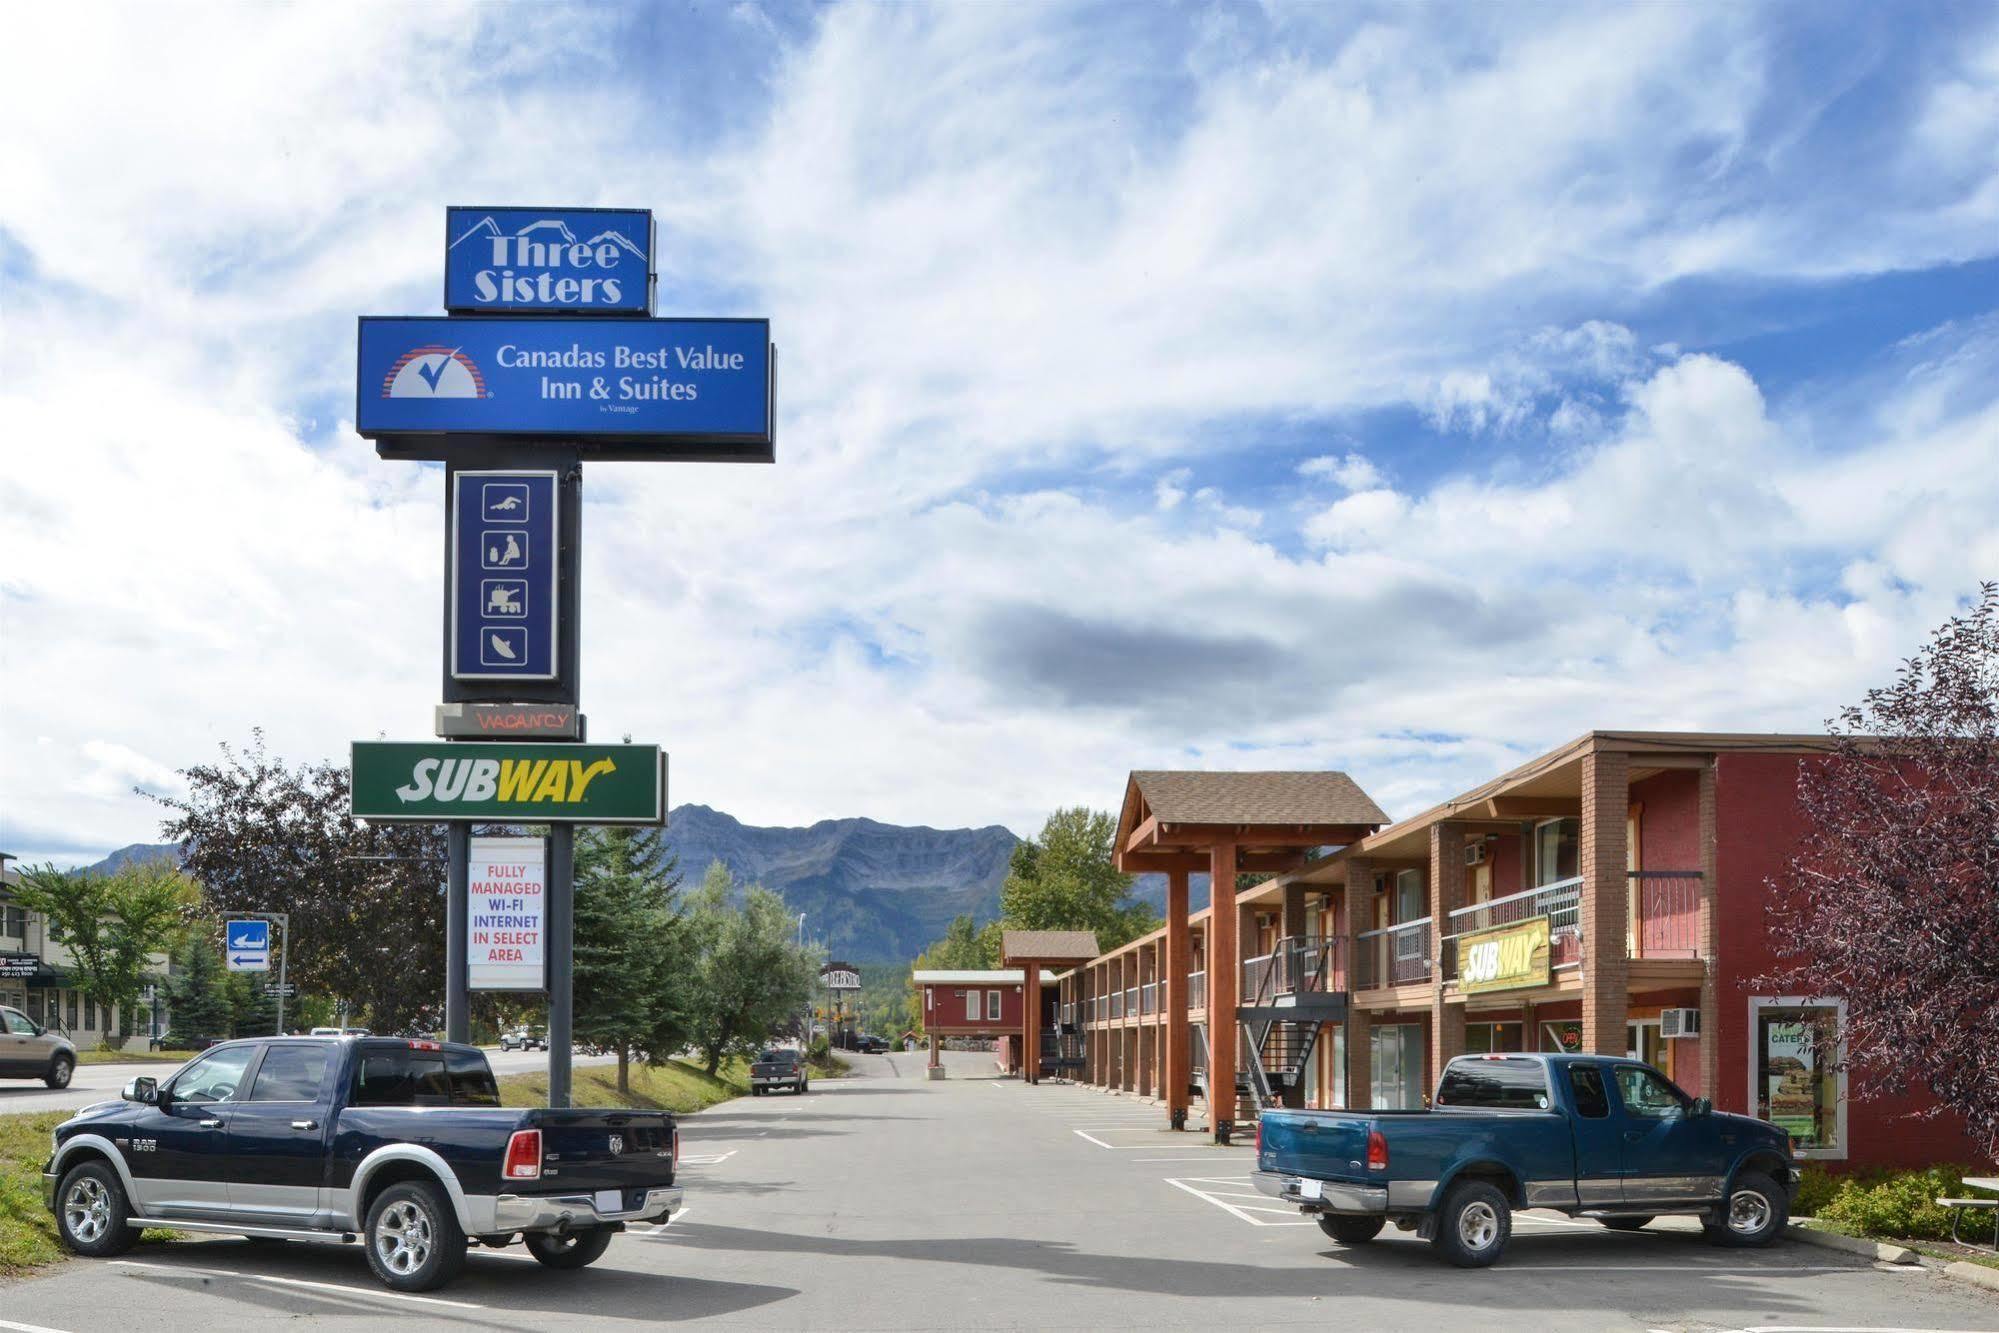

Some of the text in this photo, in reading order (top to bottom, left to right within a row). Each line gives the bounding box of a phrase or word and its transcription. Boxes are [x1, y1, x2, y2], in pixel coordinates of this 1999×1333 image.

[486, 236, 620, 268] Three
[474, 270, 622, 304] Sisters
[496, 343, 745, 370] Canadas Best Value
[541, 375, 698, 400] Inn & Suites
[608, 404, 640, 414] Vantage
[477, 712, 569, 730] VACANCY
[396, 756, 617, 804] SUBWAY
[488, 866, 525, 878] FULLY
[472, 882, 541, 895] MANAGED
[488, 899, 523, 911] WI-FI
[474, 915, 538, 928] INTERNET
[474, 932, 538, 945] IN SELECT
[488, 949, 523, 961] AREA
[1461, 927, 1542, 985] SUBWAY
